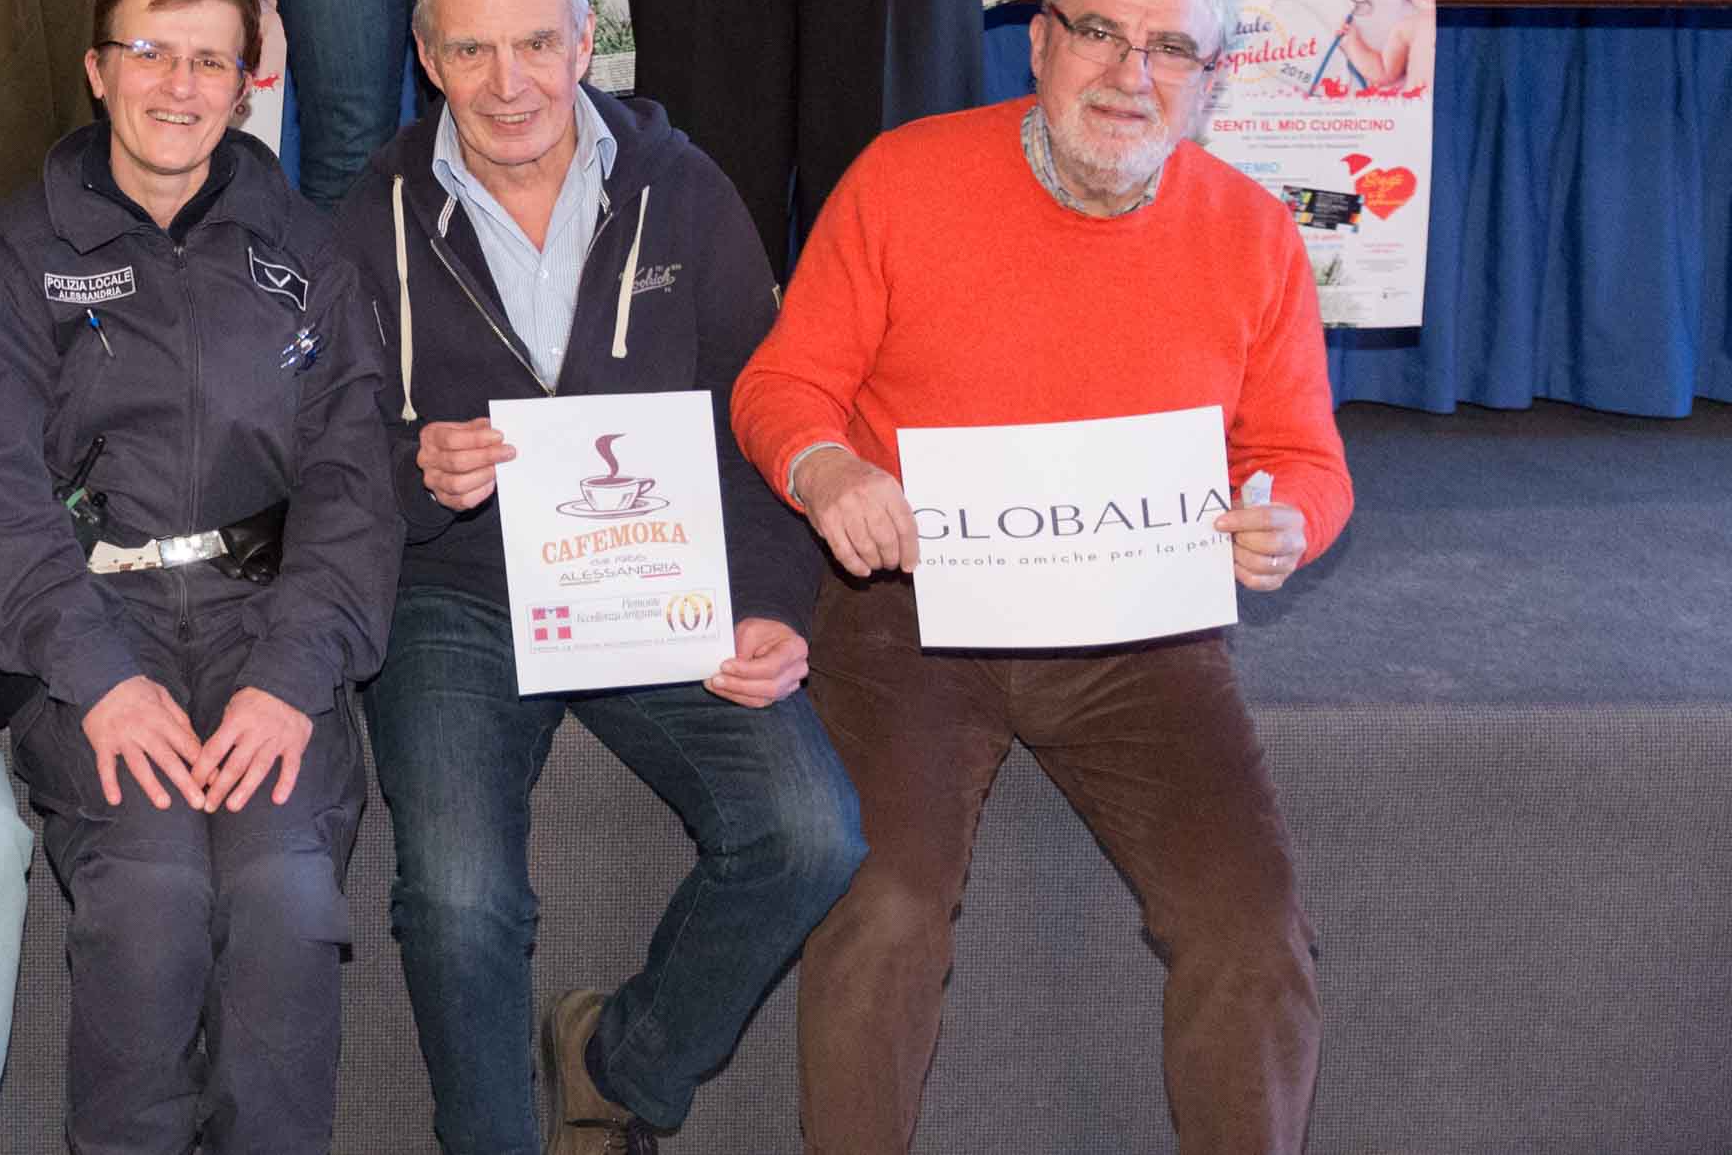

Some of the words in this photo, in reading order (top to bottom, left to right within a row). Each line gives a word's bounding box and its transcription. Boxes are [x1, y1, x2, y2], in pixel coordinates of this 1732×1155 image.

[1235, 17, 1272, 35] tale
[1212, 119, 1256, 132] SENTI
[1261, 119, 1274, 132] IL
[1278, 119, 1304, 132] MIO
[1310, 119, 1395, 132] CUORICINO
[46, 278, 87, 292] POLIZIA
[88, 271, 132, 290] LOCALE
[58, 286, 122, 301] ALESSANDRIA
[913, 487, 1232, 540] GLOBALIA
[541, 521, 690, 564] CAFEMOKA
[918, 553, 1006, 568] olecole
[1019, 549, 1098, 565] amiche
[1110, 547, 1144, 563] per
[1156, 543, 1176, 554] la
[559, 562, 680, 582] ALESSANDRIA
